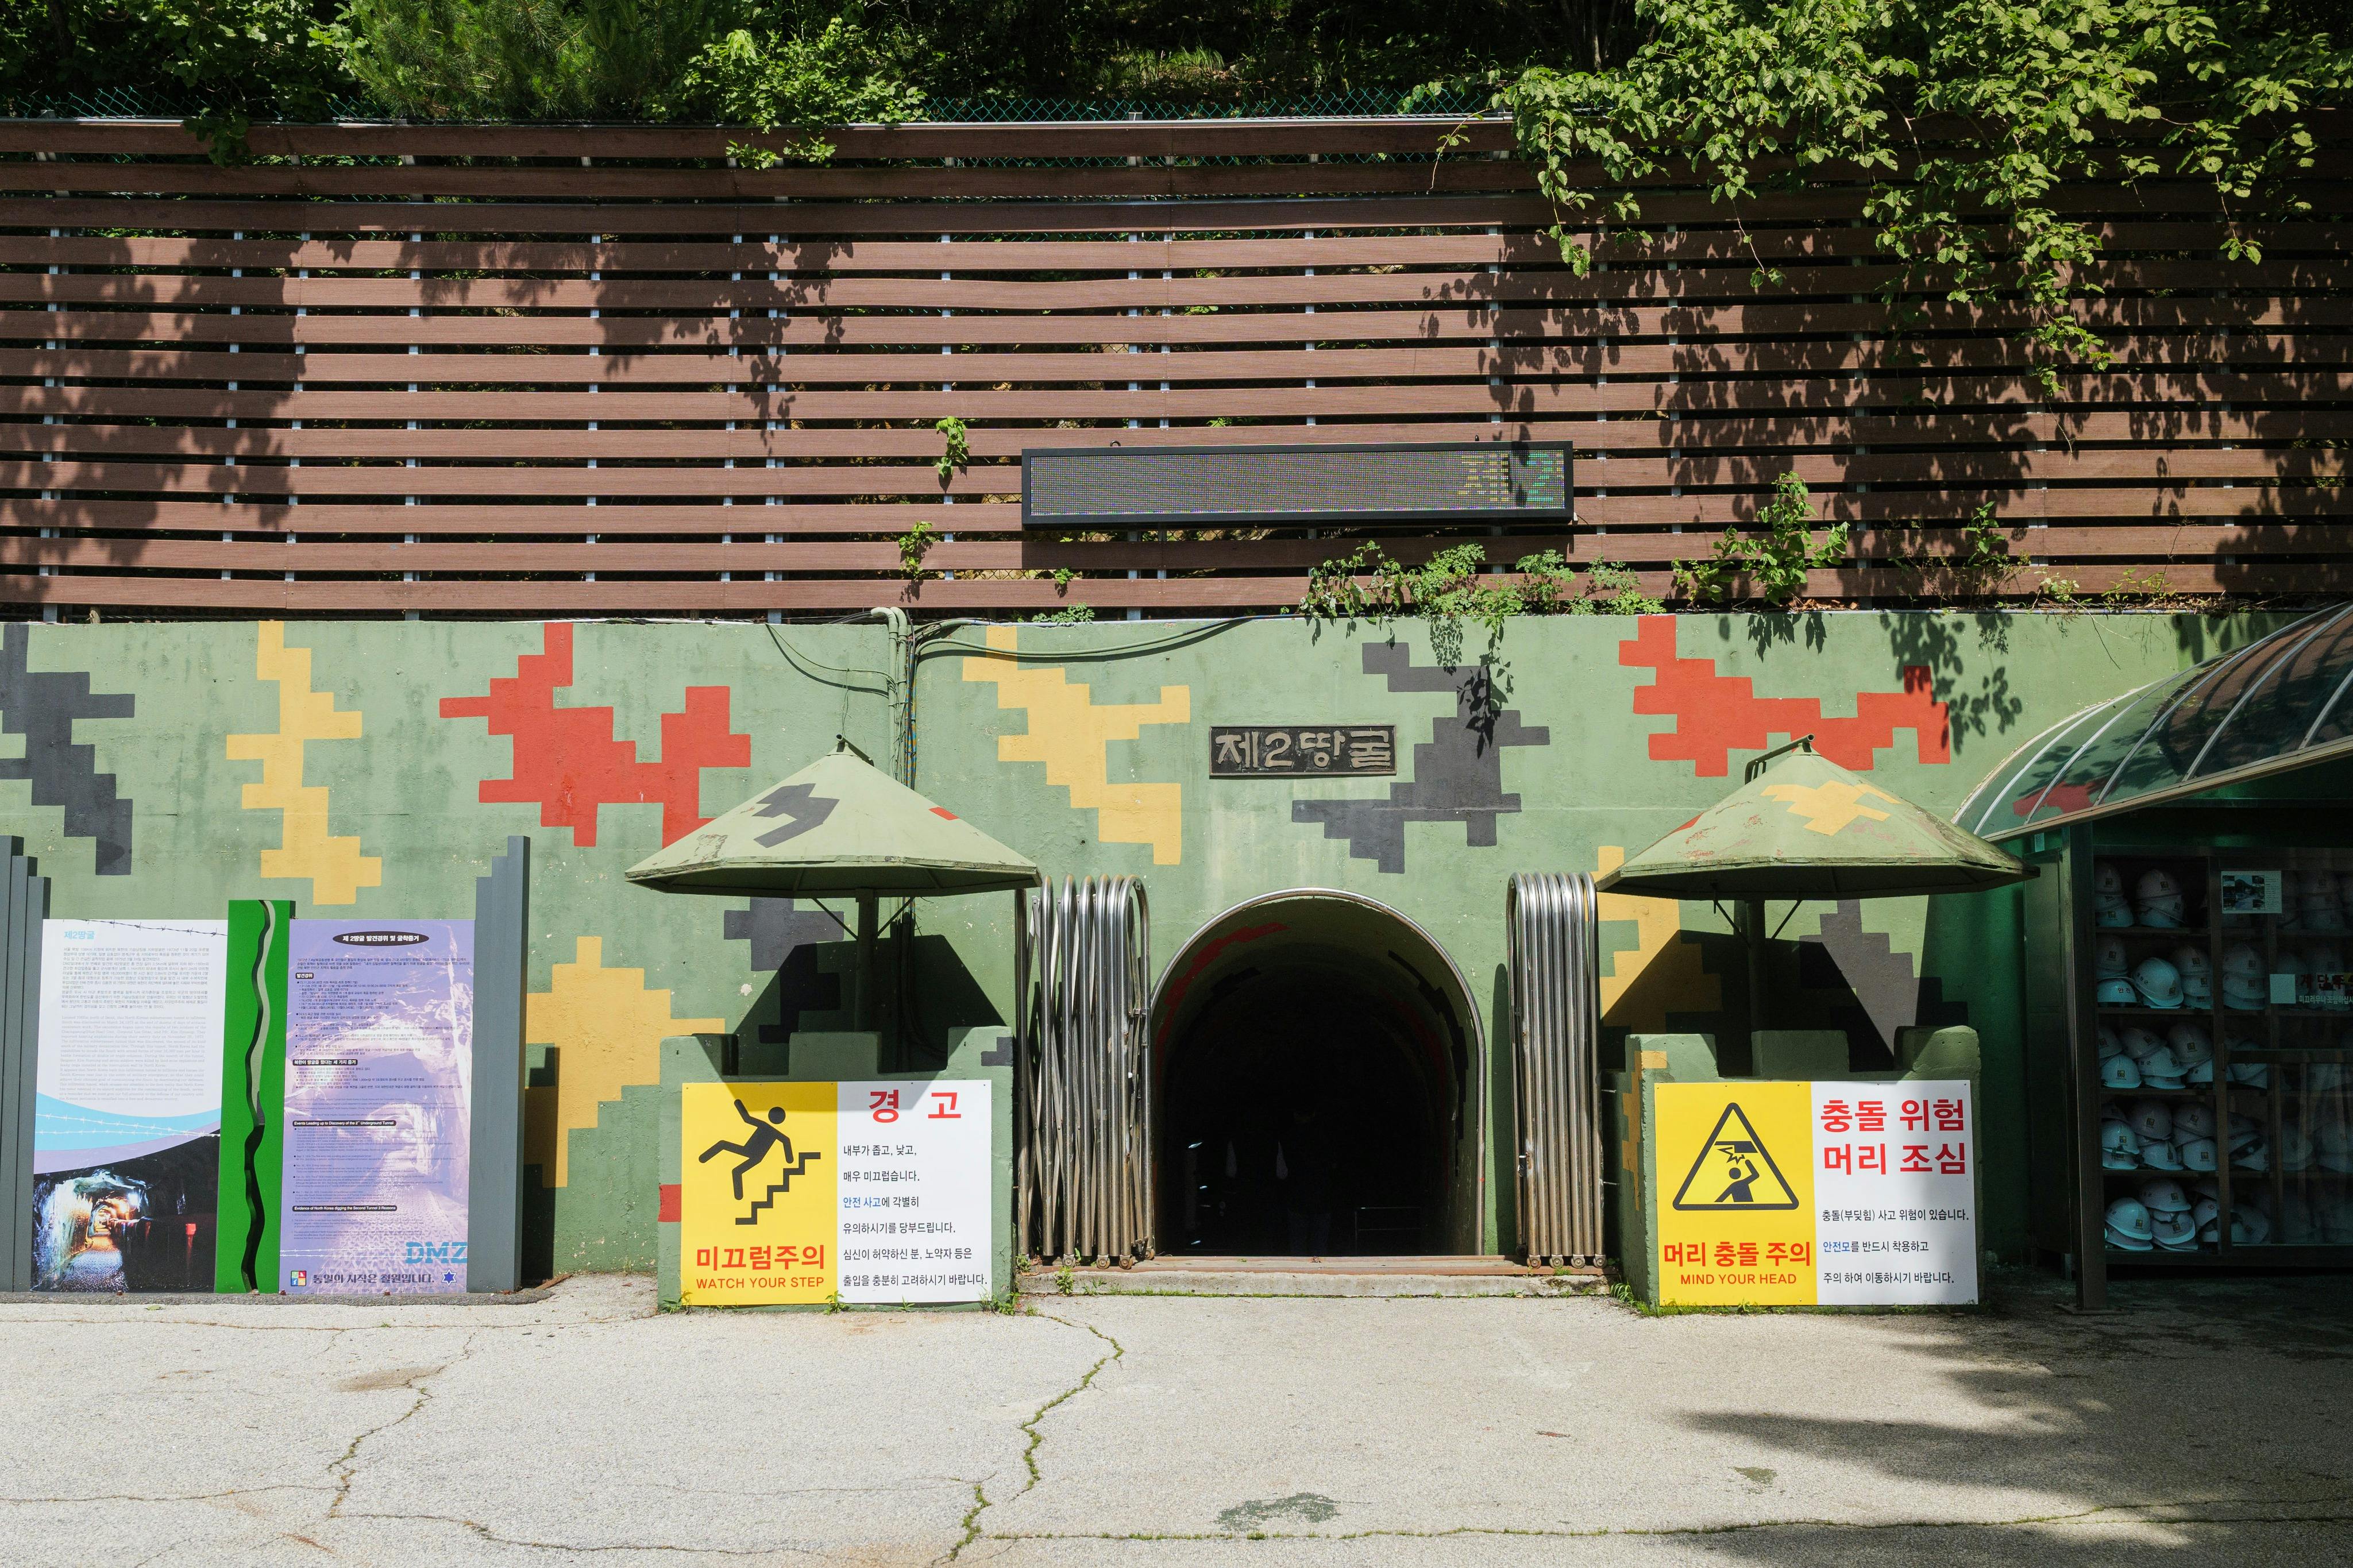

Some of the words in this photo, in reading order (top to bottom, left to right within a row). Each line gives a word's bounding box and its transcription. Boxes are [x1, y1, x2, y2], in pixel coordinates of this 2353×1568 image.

[1215, 730, 1392, 768] 제2땅굴
[64, 930, 95, 940] 제2땅굴
[1820, 1100, 1887, 1133] 충돌
[1899, 1099, 1965, 1132] 위험
[843, 1145, 870, 1156] 내부가
[872, 1145, 893, 1156] 좁고,
[896, 1144, 917, 1156] 낮고,
[1823, 1143, 1887, 1176] 머리
[1899, 1142, 1966, 1175] 조심
[843, 1171, 861, 1182] 매우
[864, 1170, 920, 1182] 미끄럽습니다.
[843, 1196, 861, 1208] 안전
[863, 1196, 890, 1208] 사고에
[893, 1196, 919, 1207] 각별히
[1822, 1209, 1876, 1222] 충돌(부딪힘)
[1878, 1209, 1896, 1221] 사고
[1899, 1209, 1926, 1221] 위험이
[1929, 1209, 1969, 1221] 있습니다.
[843, 1222, 897, 1234] 유의하시기를
[899, 1222, 955, 1234] 당부드립니다.
[405, 1241, 468, 1264] DMZ
[1823, 1241, 1860, 1253] 안전모를
[1862, 1241, 1889, 1252] 반드시
[1892, 1241, 1929, 1252] 착용하고
[696, 1245, 825, 1271] 미끄럼주의
[843, 1249, 870, 1260] 심신이
[873, 1248, 908, 1260] 허약하신
[910, 1248, 923, 1260] 분,
[925, 1248, 952, 1260] 노약자
[954, 1248, 972, 1259] 등은
[1664, 1242, 1706, 1268] 머리
[1714, 1242, 1760, 1267] 충돌
[1765, 1241, 1811, 1267] 주의
[313, 1273, 344, 1284] 통일의
[347, 1273, 377, 1284] 시작은
[380, 1273, 434, 1284] 철원입니다.
[696, 1278, 745, 1289] WATCH
[749, 1277, 786, 1288] YOUR
[790, 1277, 824, 1288] STEP
[843, 1275, 870, 1287] 출입을
[872, 1275, 898, 1286] 충분히
[901, 1274, 946, 1286] 고려하시기
[949, 1273, 988, 1285] 바랍니다.
[1680, 1274, 1715, 1285] MIND
[1718, 1274, 1756, 1285] YOUR
[1760, 1274, 1796, 1284] HEAD
[1823, 1272, 1842, 1284] 주의
[1844, 1272, 1862, 1284] 하여
[1865, 1272, 1911, 1284] 이동하시기
[1914, 1272, 1954, 1284] 바랍니다.
